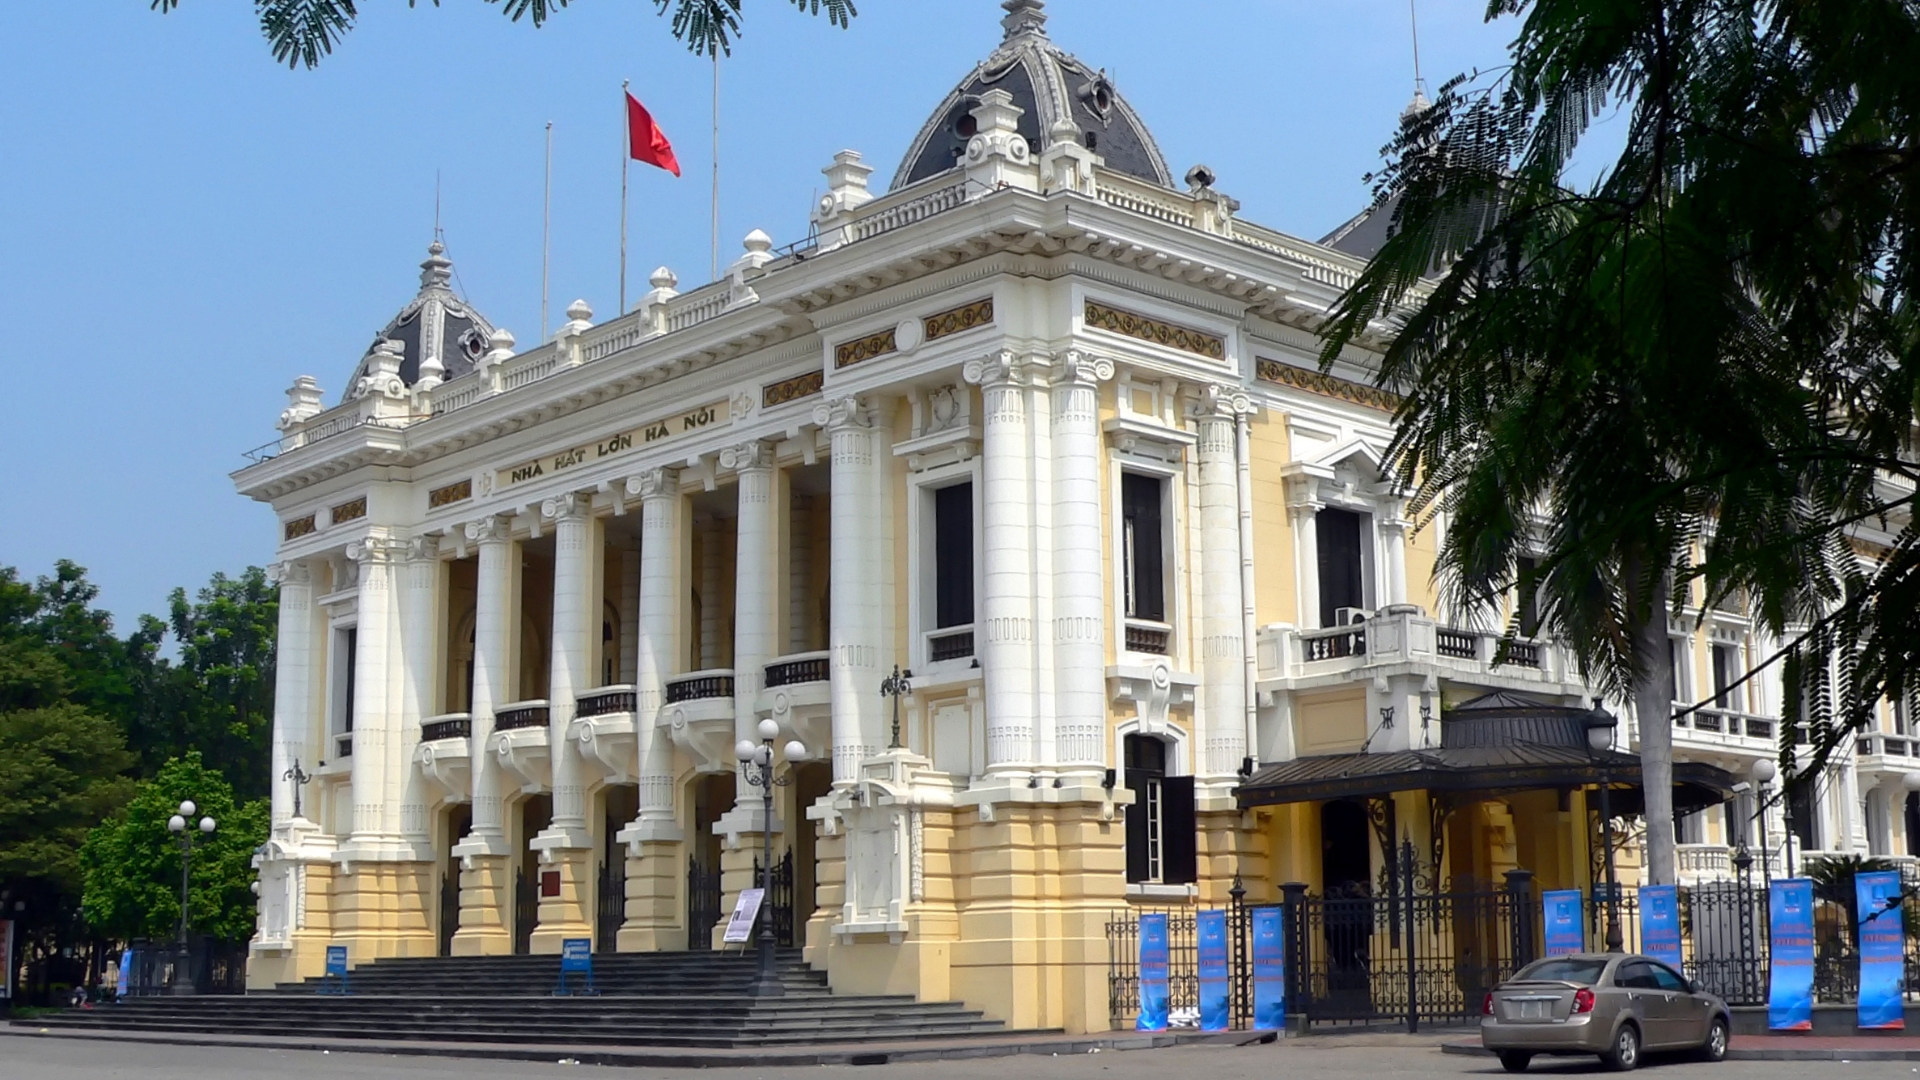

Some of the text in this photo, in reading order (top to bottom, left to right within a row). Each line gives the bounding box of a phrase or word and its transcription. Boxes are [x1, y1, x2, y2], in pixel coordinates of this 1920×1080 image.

[511, 459, 543, 483] NHÀ
[554, 448, 586, 470] HÁT
[645, 420, 670, 442] HÀ
